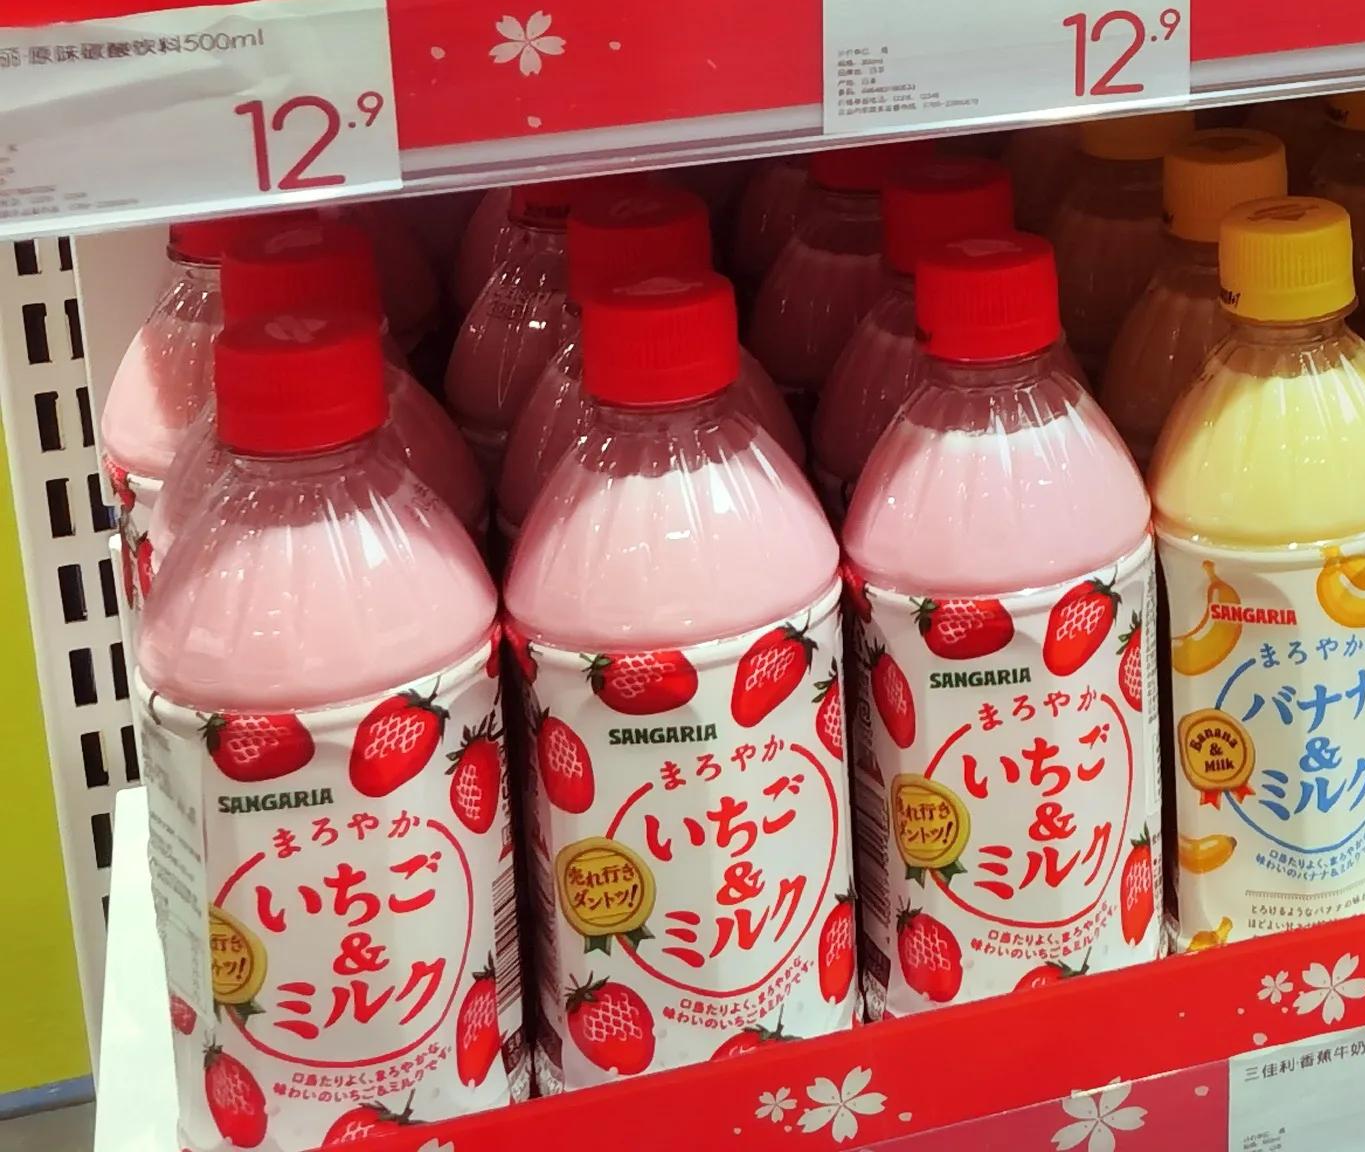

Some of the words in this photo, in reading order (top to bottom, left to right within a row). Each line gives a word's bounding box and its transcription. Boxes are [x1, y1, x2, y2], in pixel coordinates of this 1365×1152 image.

[1062, 8, 1182, 97] 12.9
[233, 91, 385, 193] 12.9
[1210, 603, 1297, 627] SANGARIA
[1259, 634, 1365, 669] まろやか
[928, 667, 1032, 690] SANGARIA
[977, 684, 1098, 732] まろやか
[608, 722, 718, 746] SANGARIA
[1191, 726, 1239, 752] Banana
[1299, 737, 1342, 772] &
[659, 733, 786, 790] まろやか
[963, 724, 1110, 800] いちご
[1204, 757, 1235, 773] Milk
[218, 787, 335, 814] SANGARIA
[644, 775, 804, 861] いちご
[1028, 802, 1076, 842] &
[271, 810, 421, 859] まろやか
[716, 860, 766, 906] &
[974, 821, 1112, 900] ミルク
[254, 850, 443, 934] いちご
[663, 874, 807, 968] ミルク
[332, 930, 391, 978] &
[273, 957, 447, 1041] ミルク
